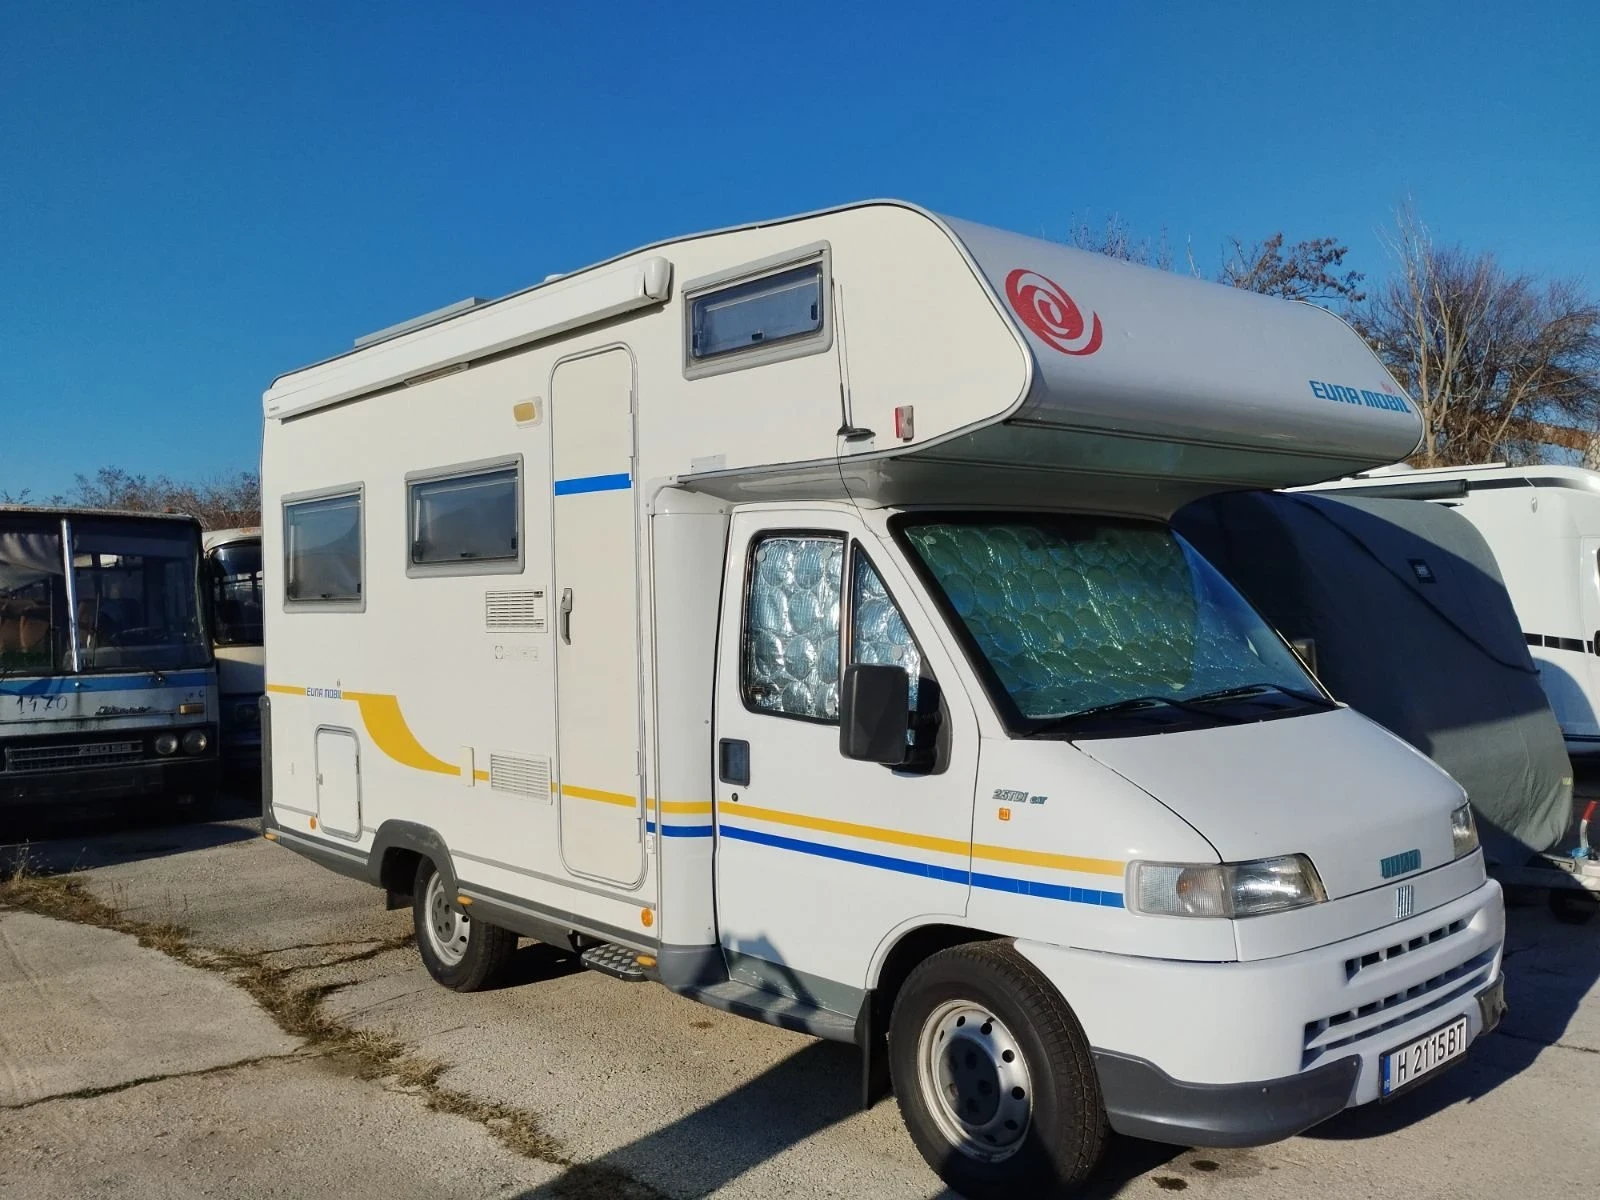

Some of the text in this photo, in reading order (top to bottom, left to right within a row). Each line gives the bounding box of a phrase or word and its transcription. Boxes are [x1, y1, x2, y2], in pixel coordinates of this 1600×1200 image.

[1309, 380, 1412, 413] EURA MOBIL
[1397, 1051, 1408, 1083] H
